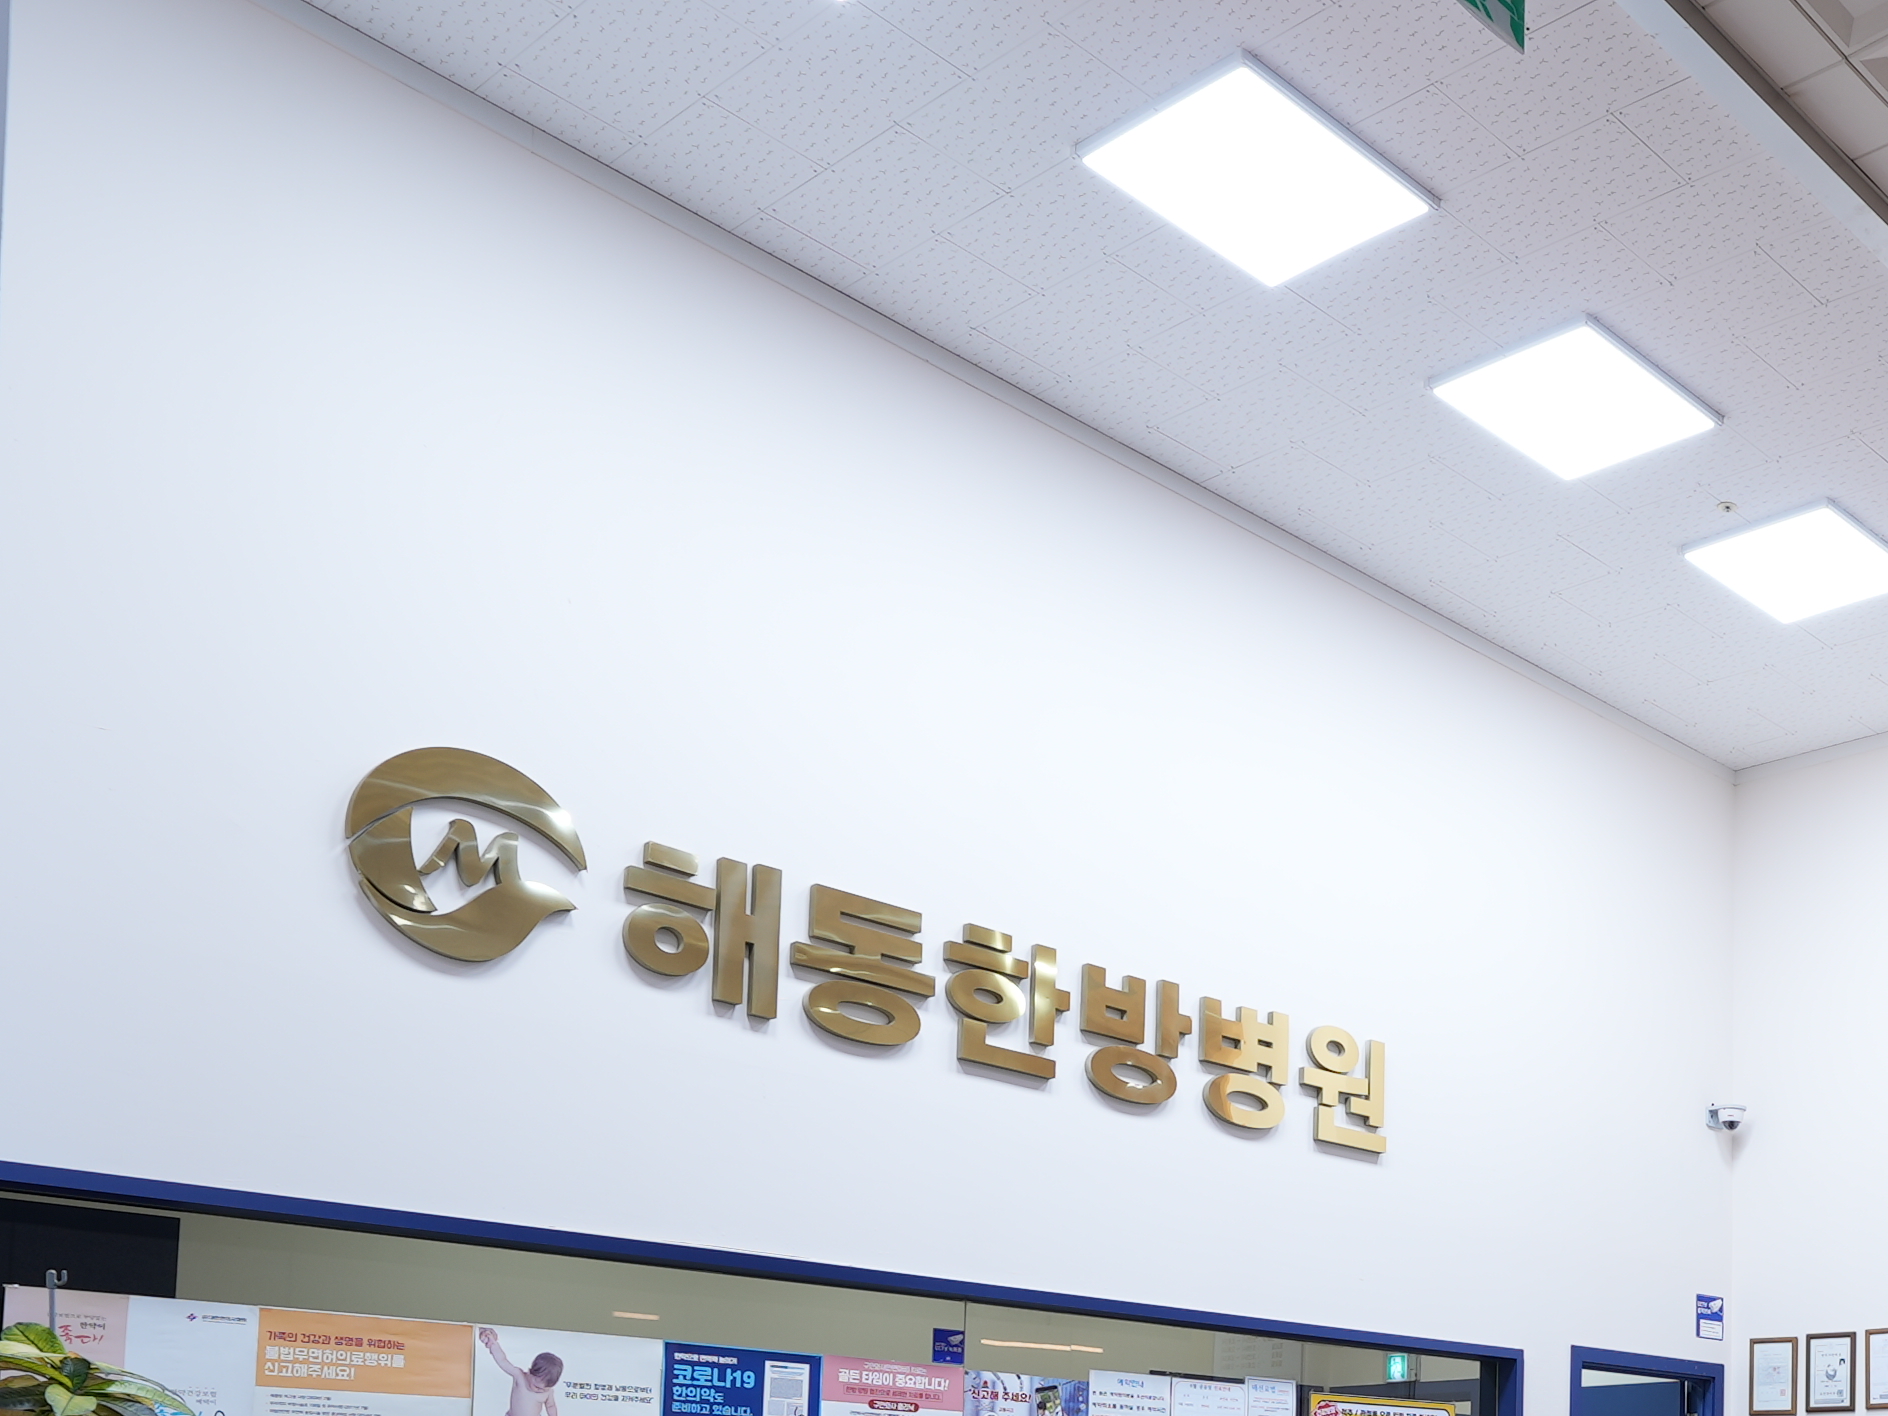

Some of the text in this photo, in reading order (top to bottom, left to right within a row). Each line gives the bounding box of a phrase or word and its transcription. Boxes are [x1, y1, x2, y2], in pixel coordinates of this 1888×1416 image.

[621, 839, 1387, 1156] 해동한방병원
[300, 1333, 331, 1345] 건강과
[264, 1362, 355, 1380] 신고해주세요!
[672, 1364, 756, 1389] 코로나19
[862, 1370, 893, 1386] 타임이
[895, 1374, 950, 1390] 중요합니다!
[672, 1385, 725, 1403] 한의약도
[971, 1390, 999, 1401] 신고해
[671, 1401, 753, 1416] 준비하고 있습니다.
